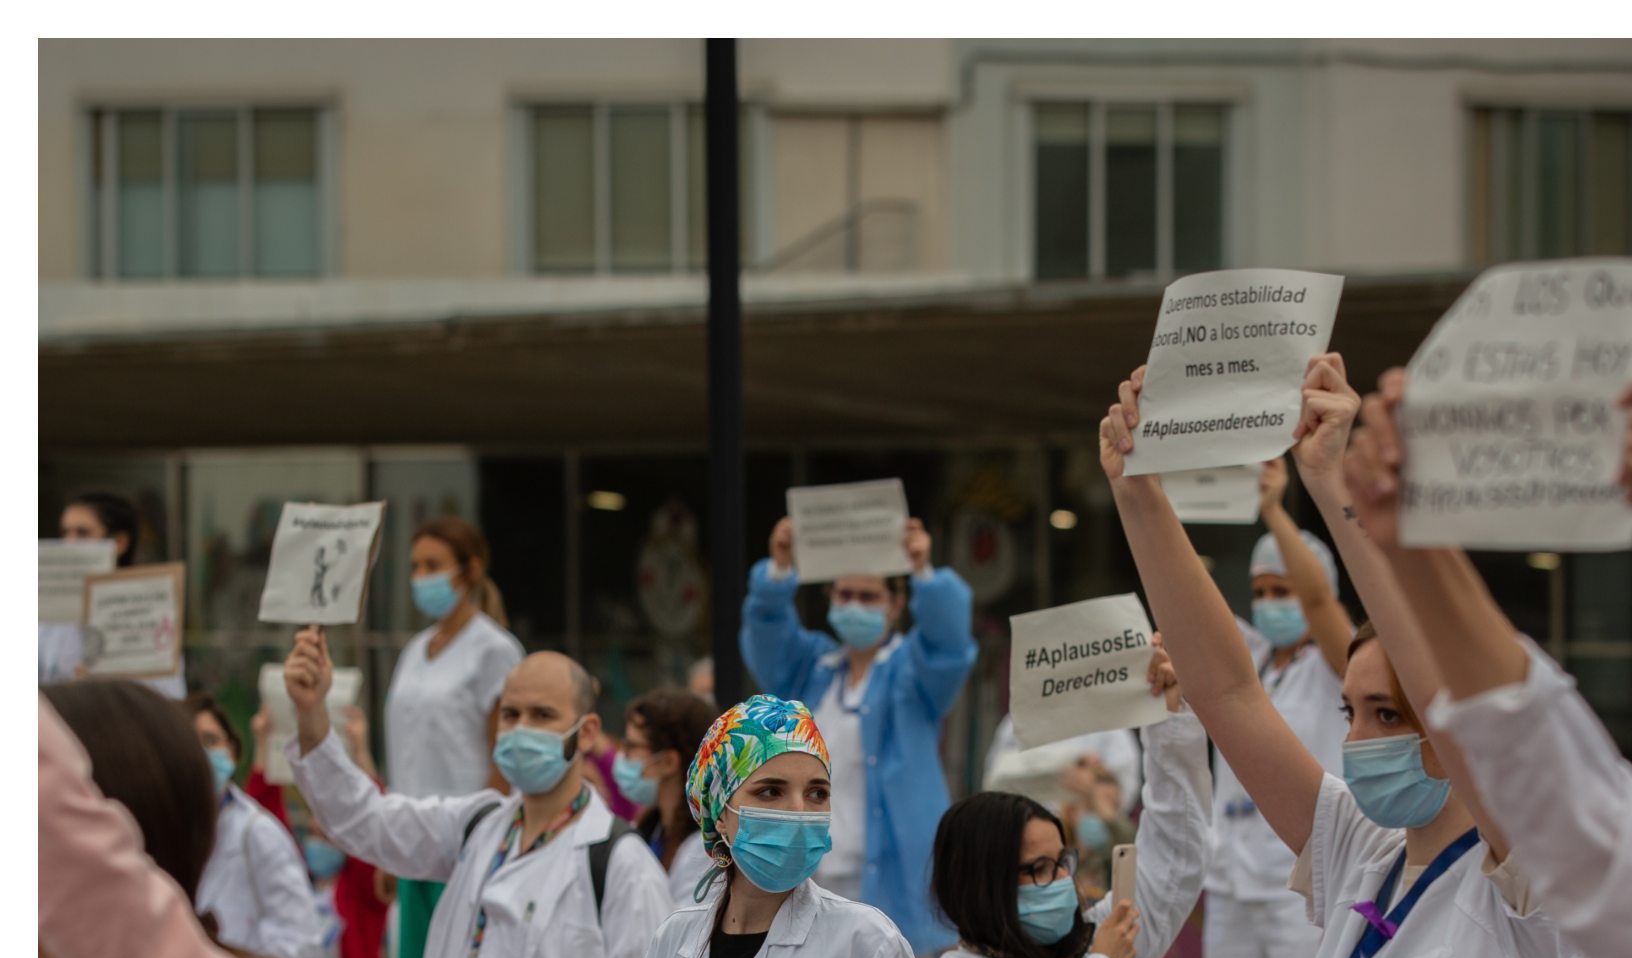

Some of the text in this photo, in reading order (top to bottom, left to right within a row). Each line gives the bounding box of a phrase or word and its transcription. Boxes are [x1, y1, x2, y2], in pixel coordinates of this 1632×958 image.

[1220, 286, 1307, 306] estabilidad
[1209, 328, 1218, 341] a
[1220, 323, 1240, 340] los
[1243, 320, 1318, 338] contratos
[1185, 359, 1260, 377] mes a mes.
[1143, 411, 1285, 440] #Aplausosenderechos
[1025, 629, 1147, 669] #AplausosEn
[1042, 667, 1128, 697] Derechos
